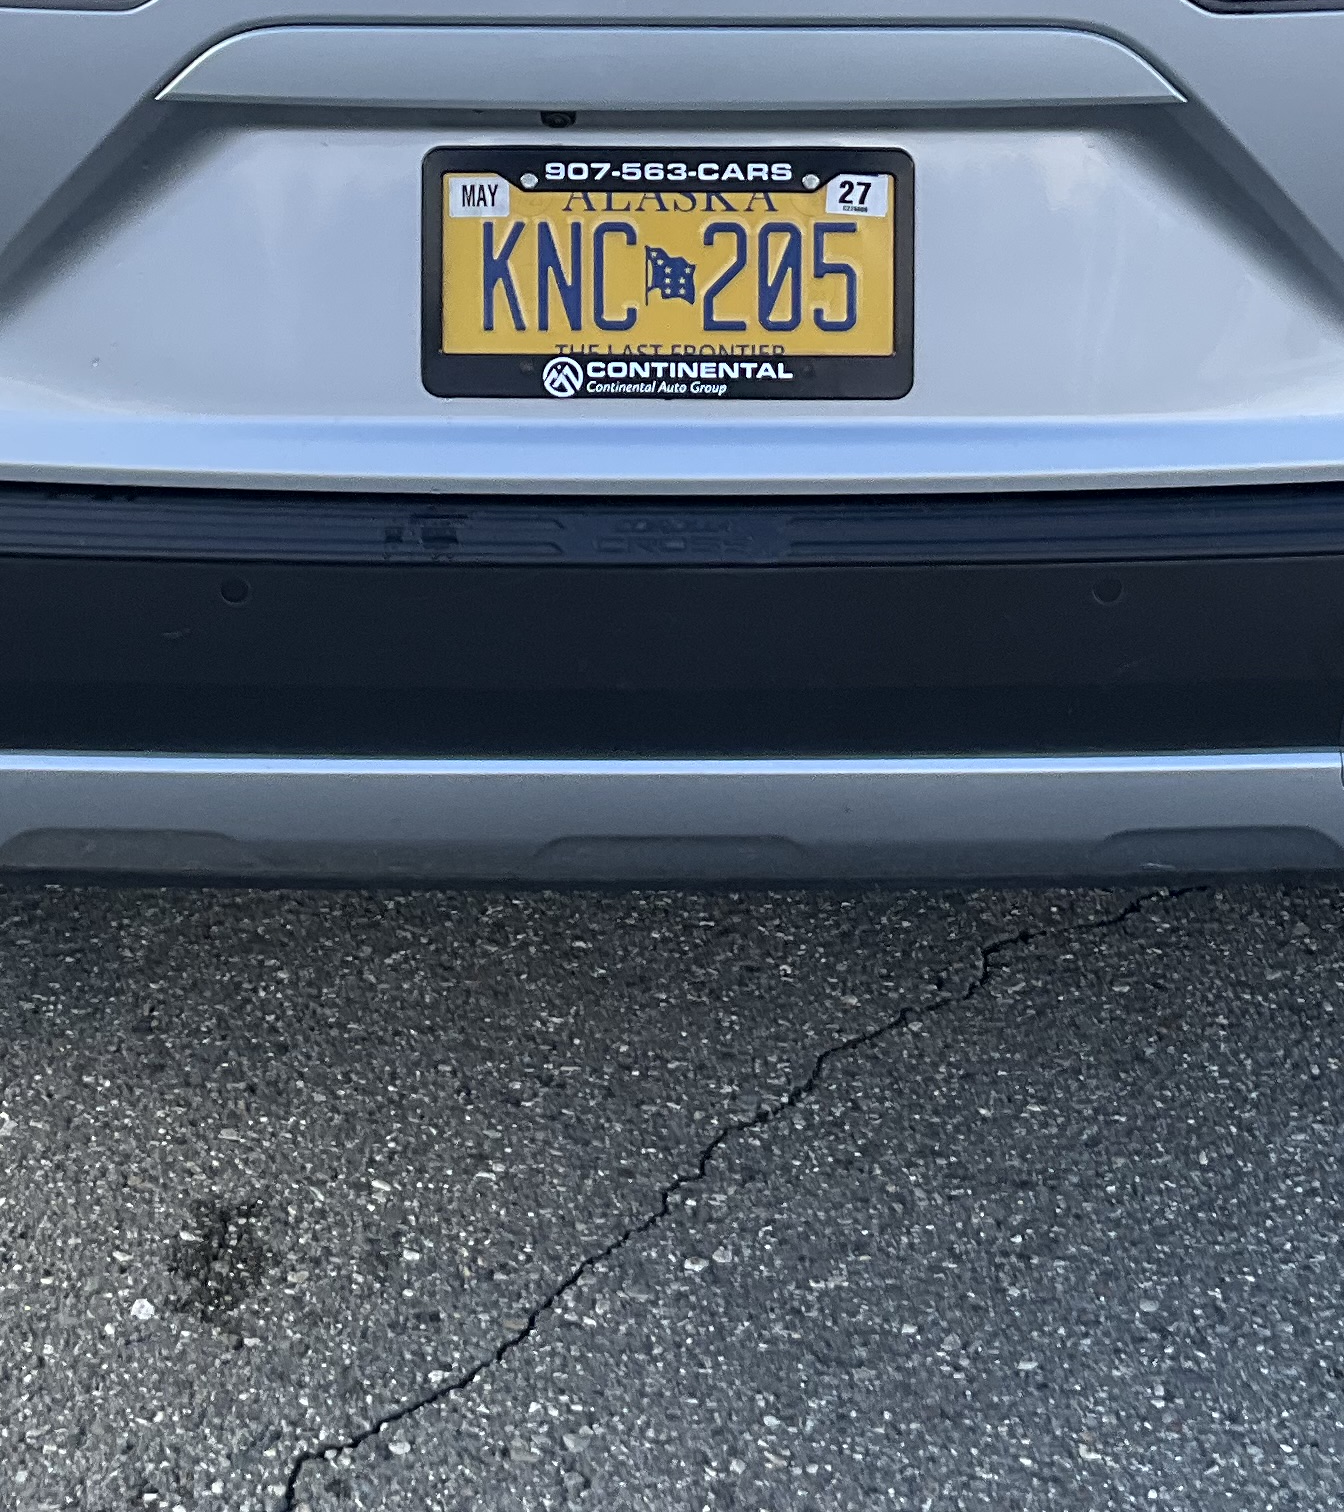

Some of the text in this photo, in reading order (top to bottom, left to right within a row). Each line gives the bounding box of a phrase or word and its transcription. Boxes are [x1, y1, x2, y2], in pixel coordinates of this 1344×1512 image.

[545, 162, 793, 181] 907-563-CARS
[461, 184, 498, 207] MAY
[838, 180, 872, 205] 27
[482, 222, 857, 331] KNC 205
[586, 361, 794, 379] CONTINENTAL
[586, 381, 728, 396] Continental Auto Group
